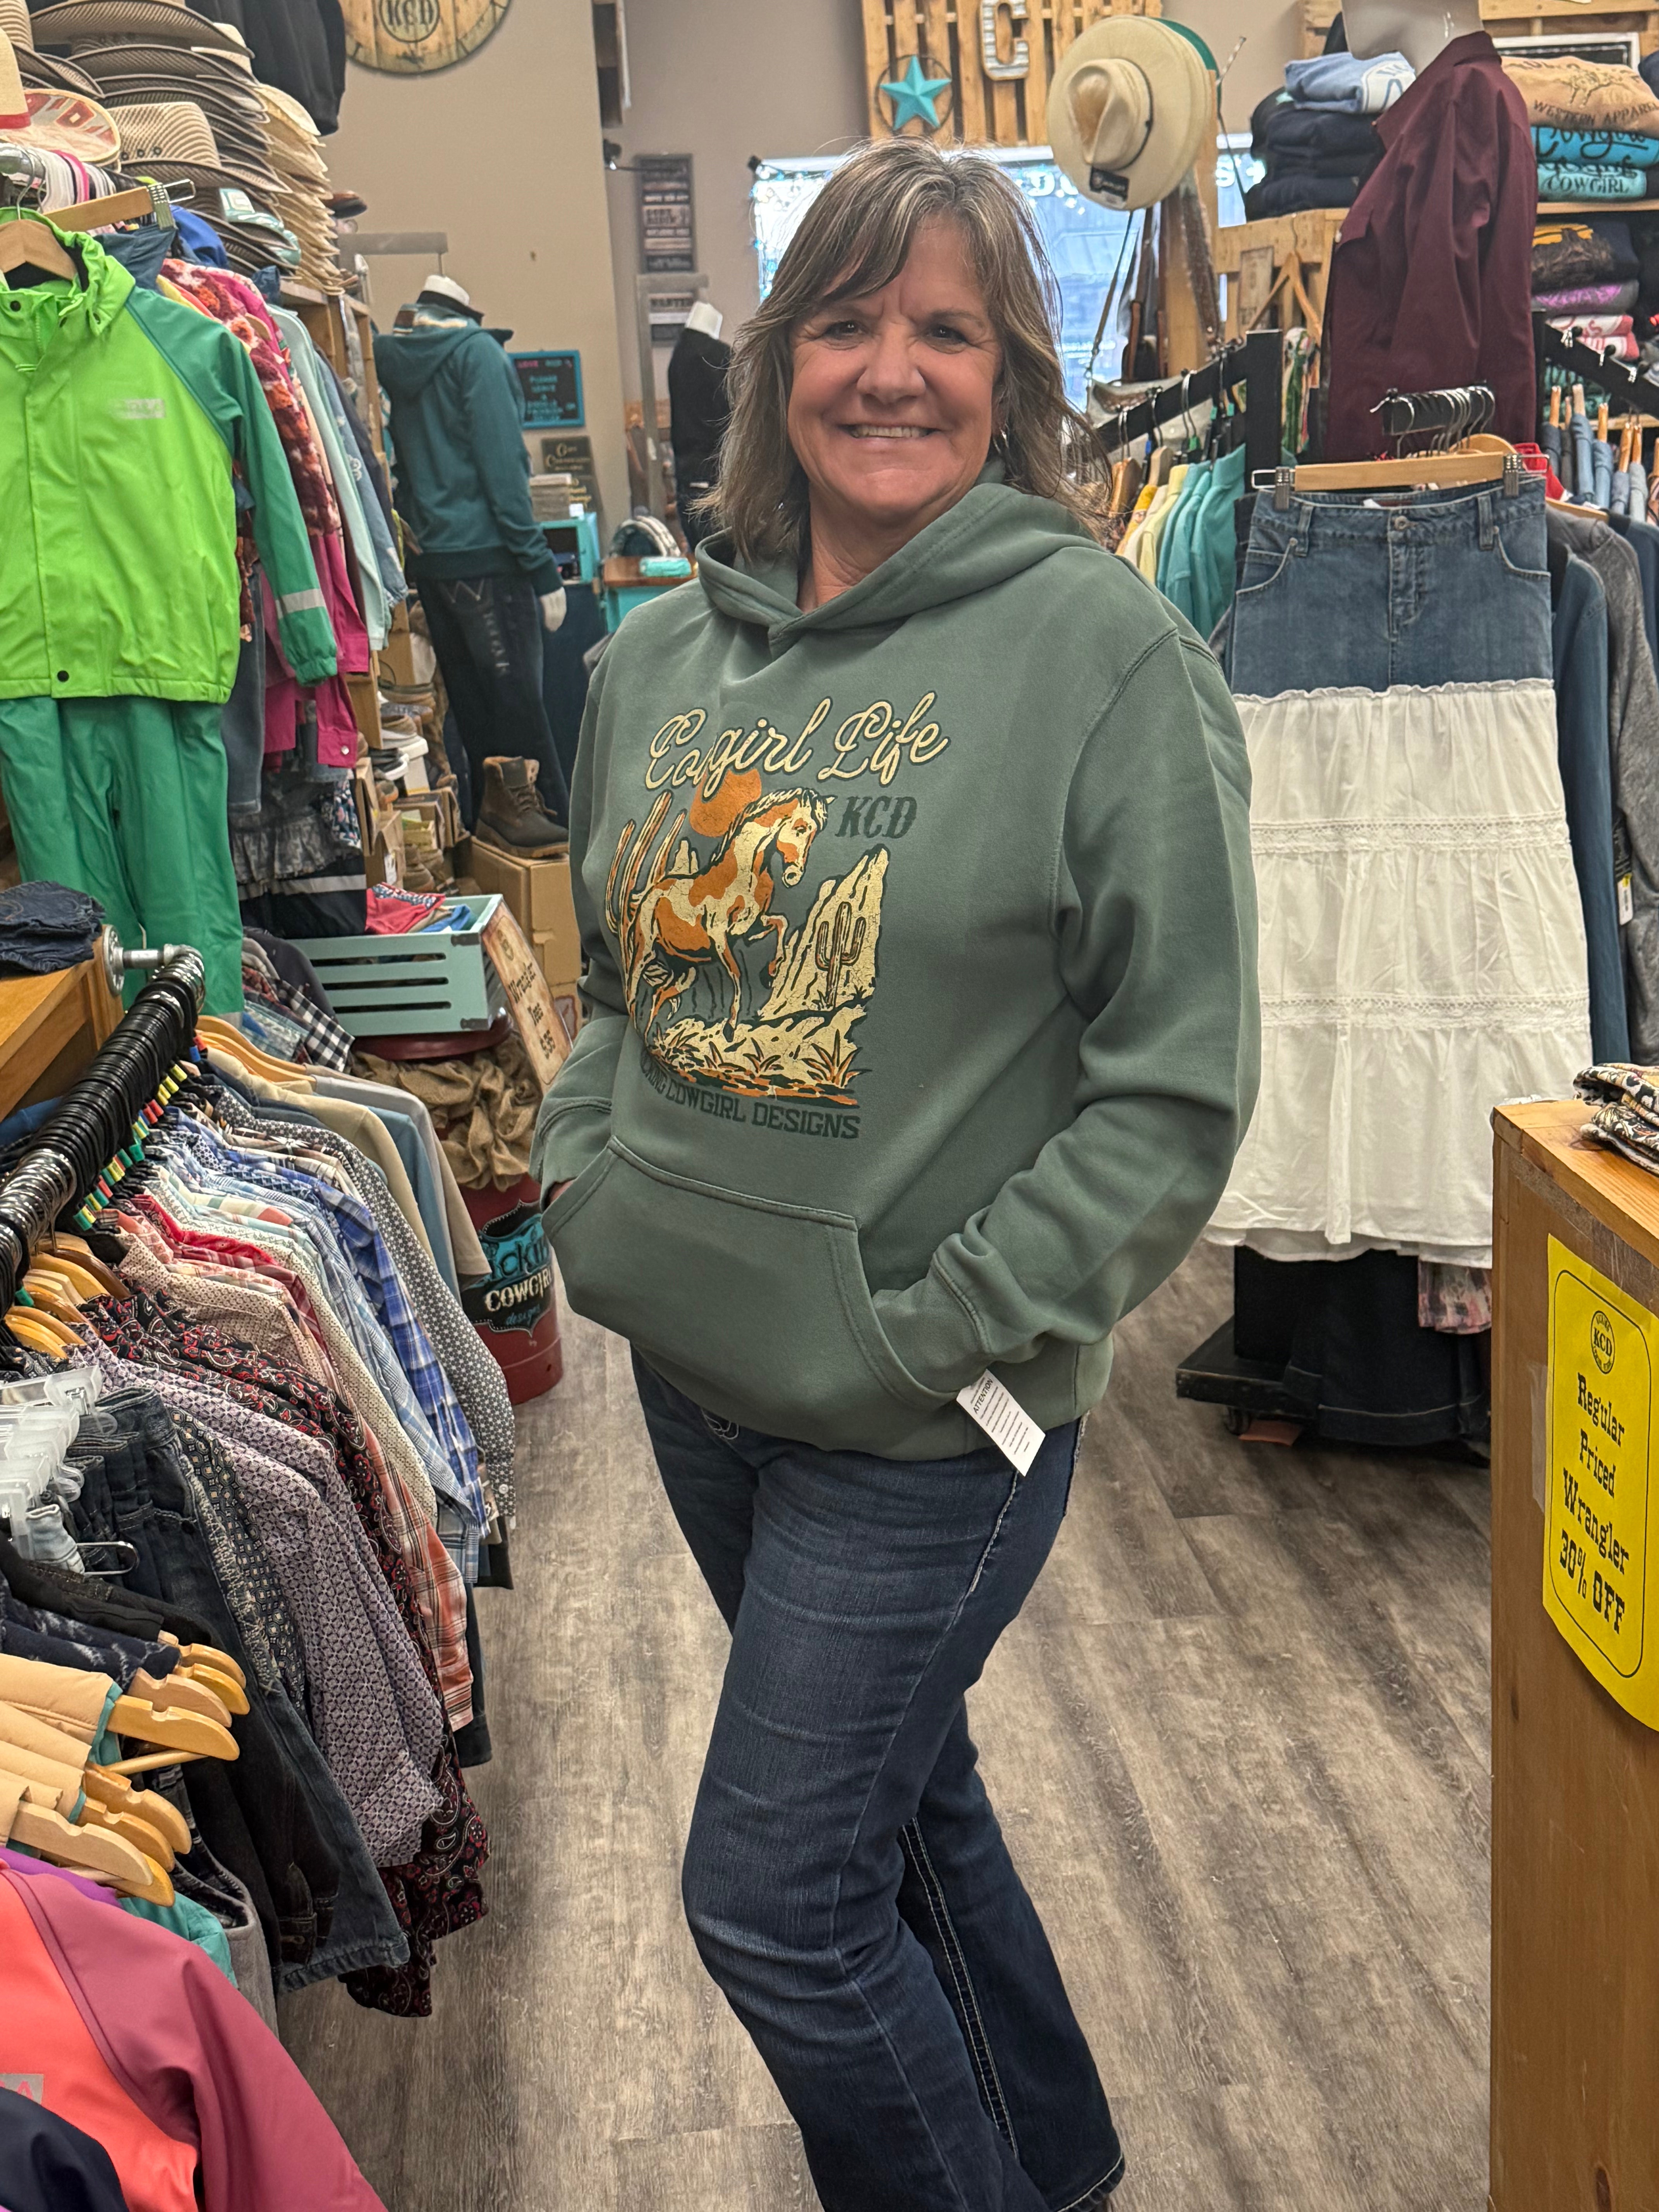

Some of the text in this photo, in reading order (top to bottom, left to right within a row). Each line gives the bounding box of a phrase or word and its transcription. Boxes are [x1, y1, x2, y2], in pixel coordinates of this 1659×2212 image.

[1534, 100, 1659, 126] WESTERN APPAREL
[1547, 175, 1629, 194] COWGIRL
[817, 691, 951, 786] Life
[835, 795, 917, 838] KCD
[665, 1079, 746, 1122] COWGIRL
[752, 1102, 861, 1139] DESIGNS
[485, 1270, 551, 1312] COWGIR
[1594, 1326, 1612, 1357] KCD
[973, 1379, 993, 1414] ATTENTION
[1578, 1372, 1625, 1448] Regular
[1579, 1428, 1616, 1499] Priced
[1563, 1467, 1629, 1575] Wrangler
[1560, 1528, 1625, 1635] 30% OFF
